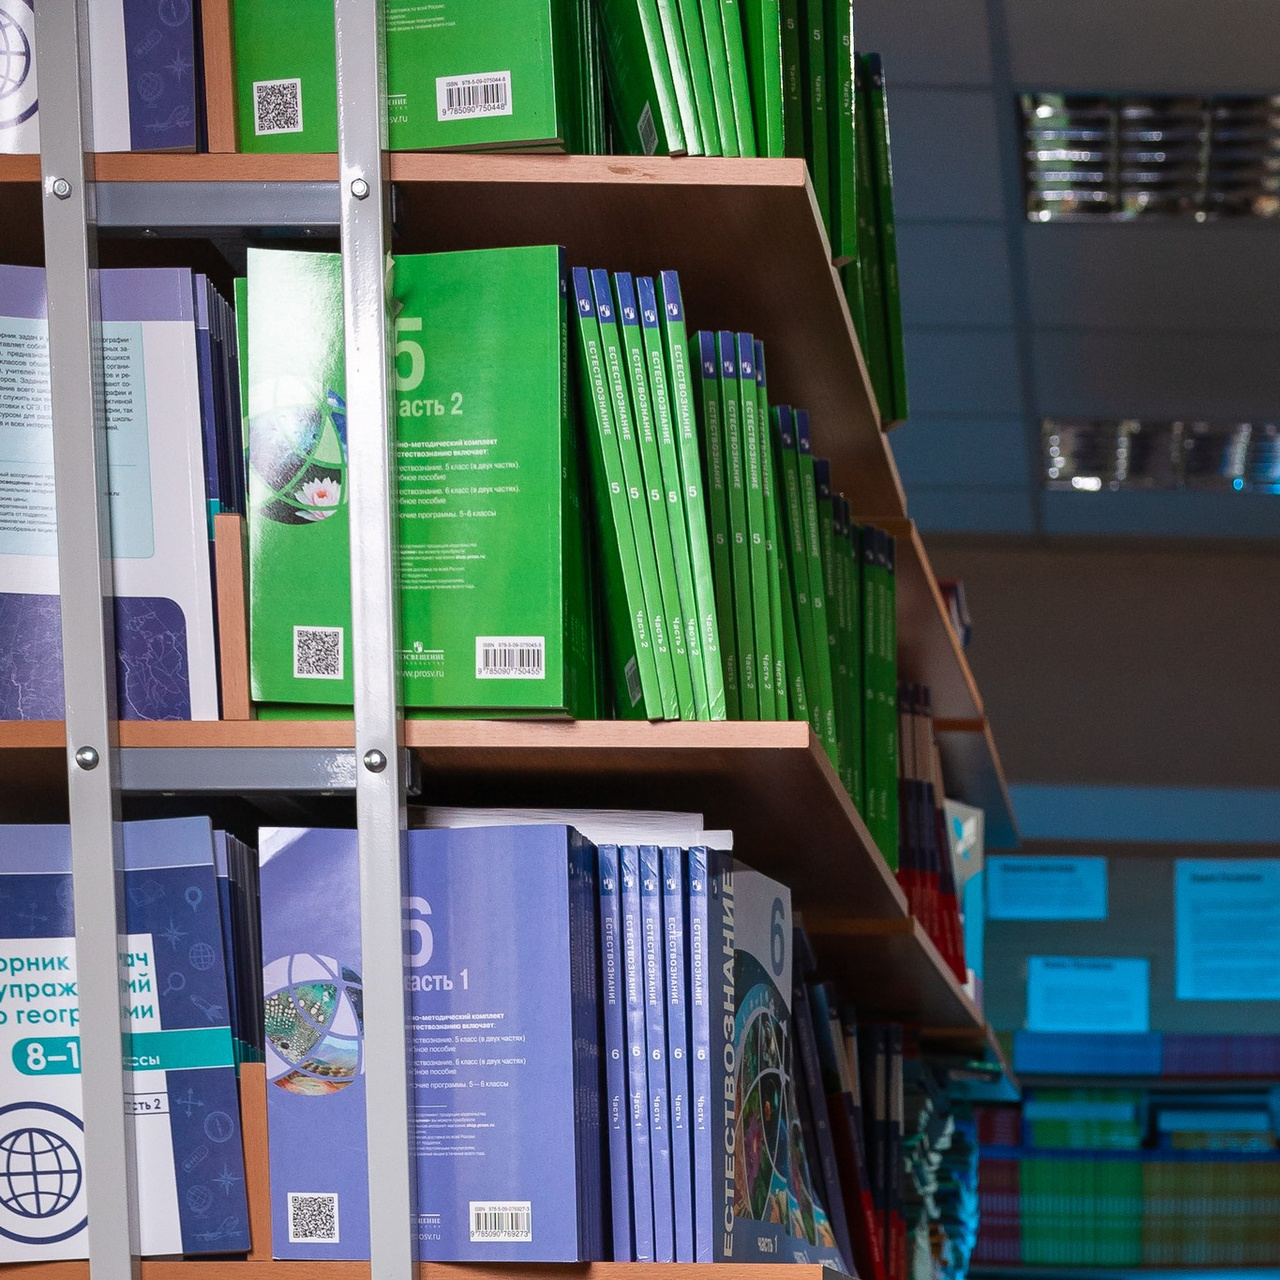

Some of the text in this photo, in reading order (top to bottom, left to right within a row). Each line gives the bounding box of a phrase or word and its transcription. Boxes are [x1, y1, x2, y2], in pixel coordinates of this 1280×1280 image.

[813, 30, 821, 41] 5
[450, 104, 476, 115] 785090
[393, 317, 425, 392] 5
[608, 346, 631, 441] ЕСТЕСТВОЗНАНИЕ
[652, 350, 671, 445] ЕСТЕСТВОЗНАНИЕ
[399, 392, 463, 418] асть 2
[464, 438, 498, 447] комплект
[588, 340, 611, 435] ЕСТЕСТВОЗНАНИЕ
[611, 482, 620, 493] 5
[636, 610, 646, 641] Часть
[632, 348, 653, 443] ЕСТЕСТВОЗНАНИЕ
[651, 489, 660, 501] 5
[672, 617, 681, 646] Часть
[674, 344, 692, 439] ЕСТЕСТВОЗНАНИЕ
[688, 486, 697, 498] 5
[706, 614, 714, 645] Часть
[746, 400, 761, 544] ЕСТЕСТВОЗНАНИЕ 5
[412, 968, 469, 992] асть 1
[606, 917, 615, 1005] ЕСТЕСТВОЗНАНИЕ
[646, 918, 656, 1006] ЕСТЕСТВОЗНАНИЕ
[693, 918, 702, 1006] ЕСТЕСТВОЗНАНИЕ
[770, 897, 785, 976] 6
[471, 1012, 504, 1020] комплект
[626, 914, 641, 1120] ЕСТЕСТВОЗНАНИЕ 6 Часть
[697, 1049, 705, 1060] 6
[723, 868, 735, 1257] ЕСТЕСТВОЗНАНИЕ
